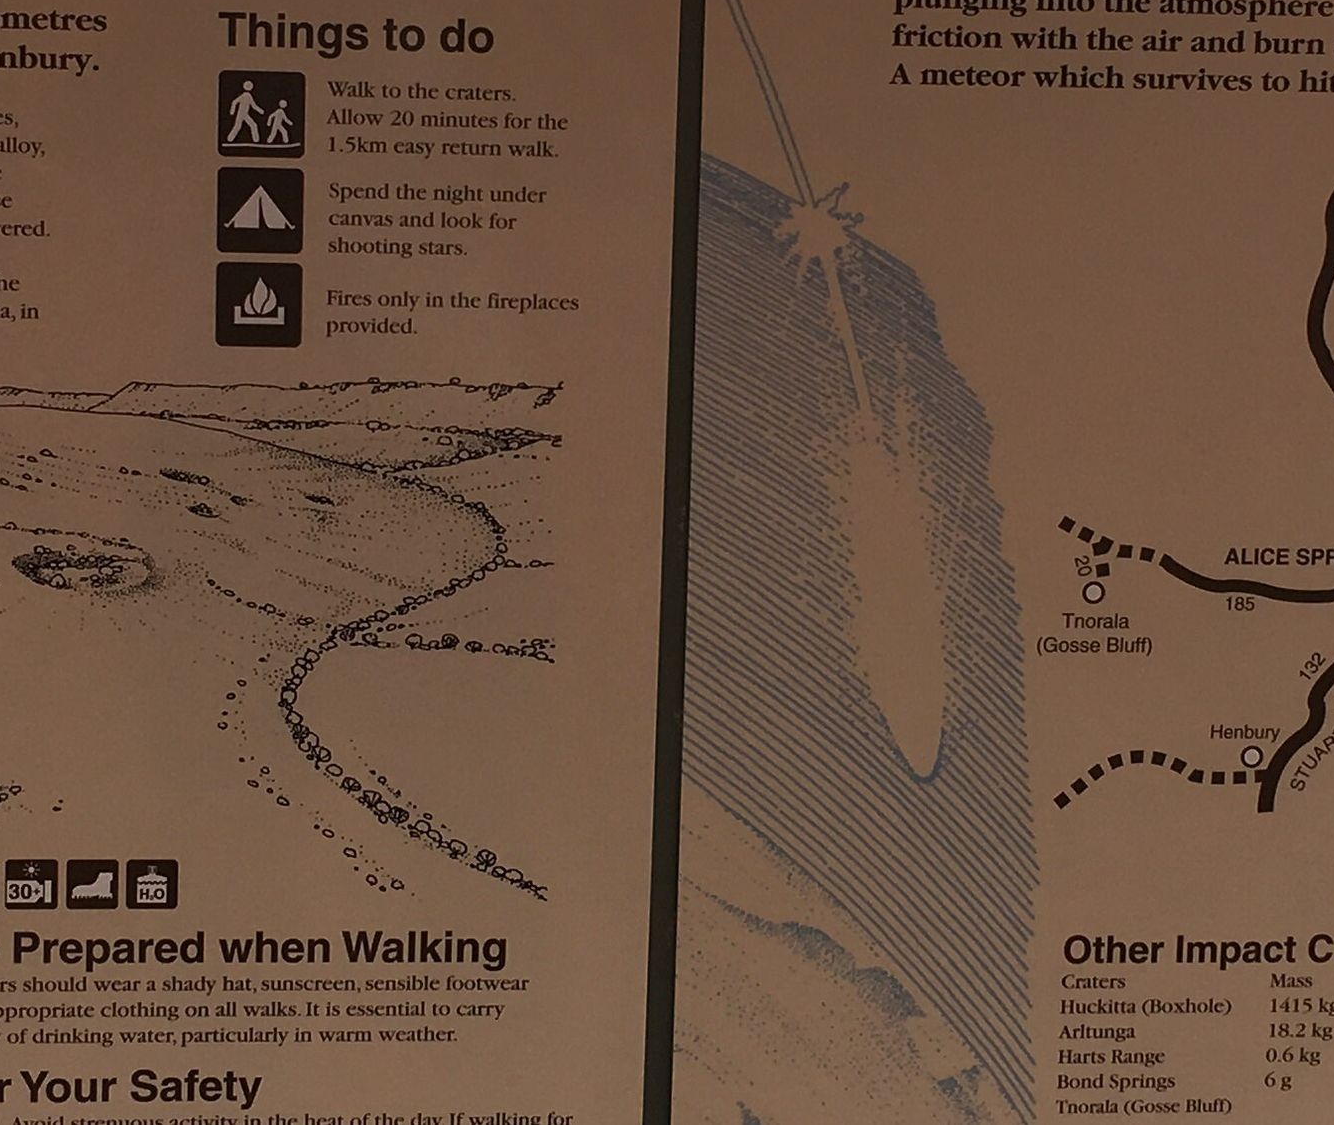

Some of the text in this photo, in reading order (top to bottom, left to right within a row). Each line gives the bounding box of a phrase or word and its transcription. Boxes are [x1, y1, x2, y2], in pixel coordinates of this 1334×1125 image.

[219, 12, 493, 59] Things to do
[330, 137, 558, 159] 1.5km easy return walk.
[21, 304, 38, 319] in
[1224, 548, 1289, 565] ALICE
[1074, 556, 1093, 577] 20
[1226, 596, 1255, 612] 185
[1062, 613, 1129, 629] Tnorala
[1037, 637, 1152, 656] (Gosse Bluff)
[1300, 652, 1327, 681] 132
[1210, 724, 1280, 742] Henbury
[14, 931, 204, 972] Prepared
[219, 931, 330, 963] when
[341, 930, 507, 971] Walking
[1064, 935, 1164, 964] Other
[1176, 935, 1296, 970] Impact
[1062, 975, 1125, 989] Craters
[1271, 974, 1312, 988] Mass
[1061, 998, 1231, 1016] Huckitta (Boxhole)
[1271, 998, 1312, 1012] 1415
[1059, 1024, 1135, 1042] Arltunga
[1270, 1023, 1332, 1041] 18.2 kg
[1059, 1050, 1165, 1067] Harts Range
[1266, 1047, 1320, 1066] 0.6 kg
[20, 1071, 117, 1103] Your
[131, 1069, 262, 1110] Safety
[1058, 1074, 1175, 1092] Bond Springs
[1265, 1071, 1291, 1091] 6 g
